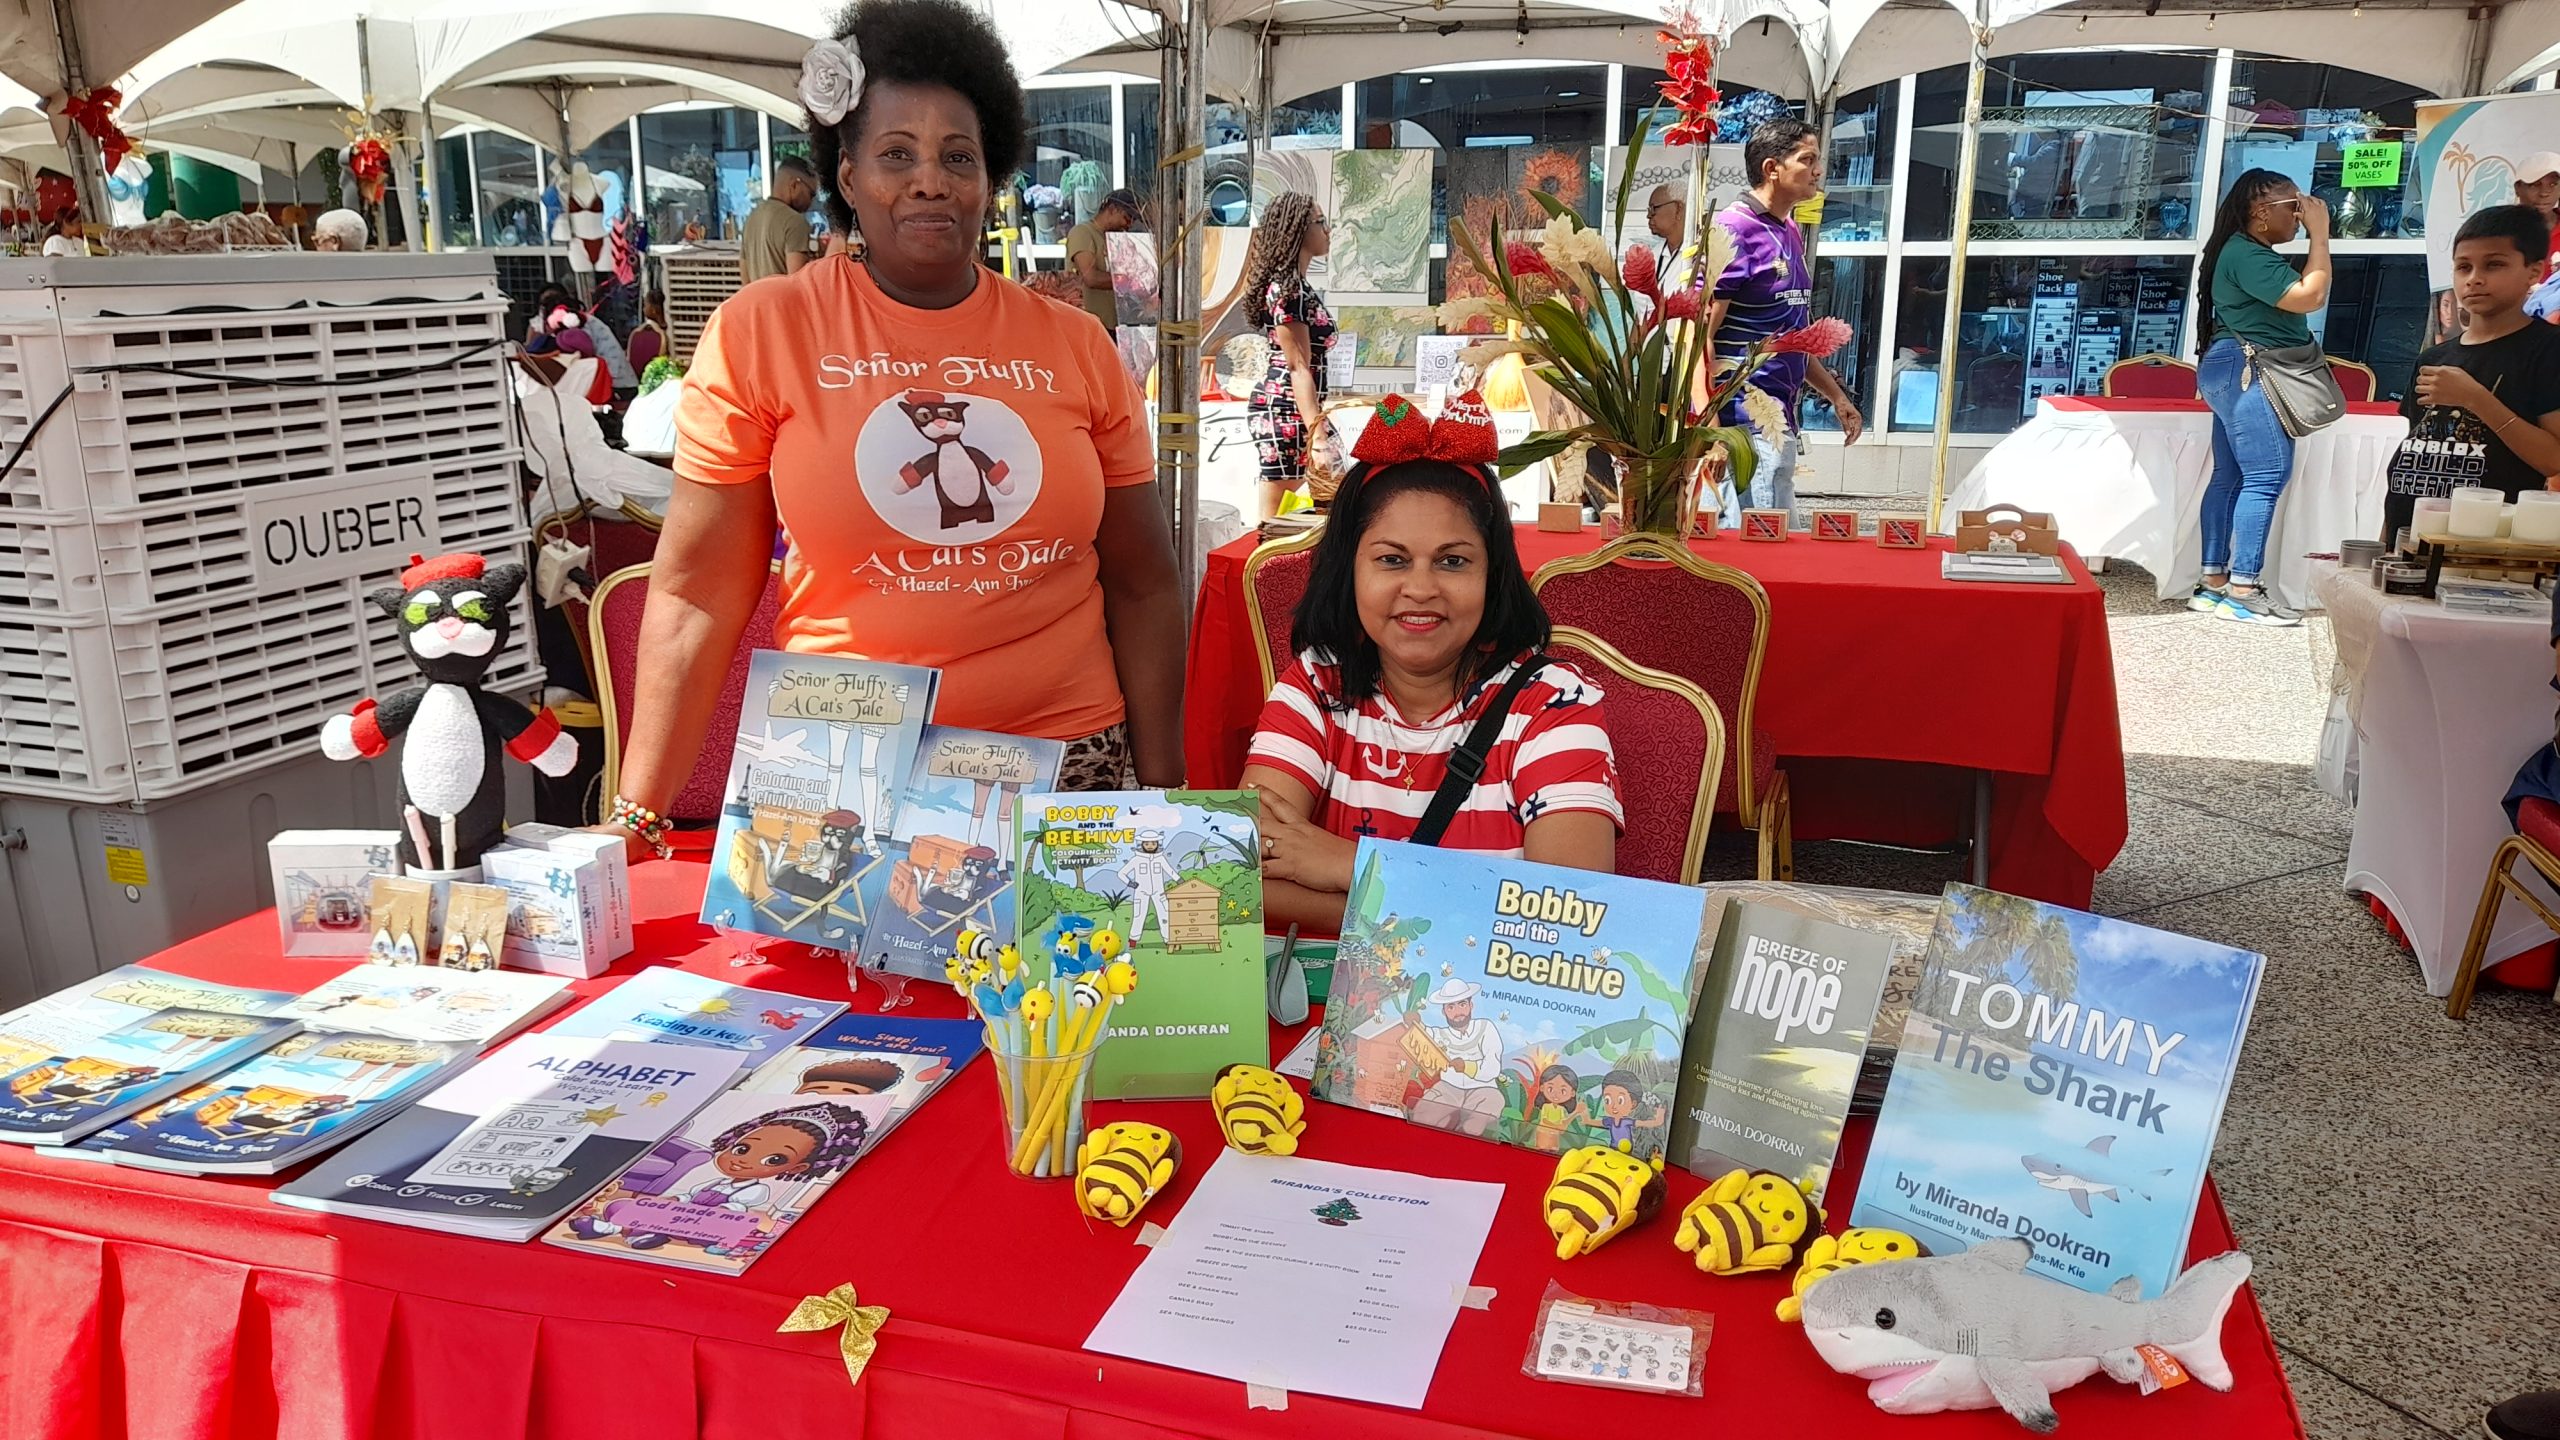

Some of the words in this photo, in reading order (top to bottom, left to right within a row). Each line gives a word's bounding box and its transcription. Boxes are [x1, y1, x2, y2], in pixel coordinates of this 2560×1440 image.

[2355, 148, 2387, 157] SALE!
[2348, 161, 2368, 169] 50%
[2372, 160, 2392, 168] OFF
[2355, 170, 2382, 179] VASES
[2038, 272, 2064, 282] Shoe
[2109, 282, 2133, 291] Shoe
[2037, 283, 2062, 293] Rack
[2141, 289, 2167, 298] Shoe
[2140, 301, 2165, 309] Rack
[817, 352, 928, 388] Señor
[938, 356, 1060, 393] Fluffy
[2401, 438, 2487, 457] ROBLOX
[2398, 452, 2486, 477] BUILD
[265, 497, 426, 565] OUBER
[852, 551, 897, 577] A
[898, 545, 986, 573] Cats
[999, 538, 1074, 573] Tale
[779, 669, 830, 691] Señor
[784, 695, 803, 714] A
[805, 695, 843, 714] Cat's
[851, 700, 884, 719] Tale
[939, 740, 979, 756] Señor
[941, 759, 958, 774] A
[960, 759, 989, 776] Cat's
[992, 763, 1021, 779] Tale
[752, 769, 805, 793] Coloring
[806, 779, 831, 795] and
[748, 787, 796, 809] Activity
[796, 794, 827, 813] Book
[800, 816, 820, 826] Lynch
[1045, 805, 1119, 822] BOBBY
[1045, 828, 1136, 846] BEEHIVE
[1051, 849, 1101, 857] COLOURING
[1495, 878, 1607, 936] Bobby
[1493, 919, 1526, 939] and
[1529, 923, 1559, 945] the
[892, 935, 948, 957] Hazel-Ann
[1757, 938, 1819, 969] BREEZE
[1822, 956, 1848, 975] OF
[1485, 940, 1624, 999] Beehive
[1729, 935, 1842, 1043] hope
[1481, 990, 1490, 1000] by
[1492, 990, 1540, 1008] MIRANDA
[1543, 998, 1596, 1018] DOOKRAN
[632, 1013, 698, 1035] Reading
[698, 1027, 715, 1035] is
[1106, 1025, 1149, 1038] ANDA
[1155, 1024, 1230, 1037] DOOKRAN
[1947, 969, 2187, 1077] TOMMY
[837, 1034, 881, 1047] Where
[885, 1042, 910, 1050] are
[909, 1046, 947, 1054] you?
[875, 1033, 918, 1044] Sleep!
[527, 1056, 696, 1087] ALPHABET
[554, 1073, 586, 1084] Color
[590, 1078, 615, 1087] and
[617, 1081, 655, 1091] Learn
[1932, 1023, 2012, 1082] The
[2024, 1052, 2171, 1135] Shark
[557, 1083, 617, 1096] Workbook
[1693, 1063, 1699, 1071] A
[1700, 1066, 1737, 1083] tumultuous
[1738, 1079, 1762, 1093] journey
[1764, 1087, 1773, 1096] of
[1772, 1089, 1809, 1109] discovering
[1696, 1073, 1737, 1093] experiencing
[1737, 1086, 1750, 1096] loss
[1751, 1092, 1765, 1102] and
[1766, 1096, 1799, 1115] rebuilding
[562, 1092, 602, 1105] A-Z
[1688, 1107, 1741, 1136] MIRANDA
[1744, 1126, 1805, 1158] DOOKRAN
[366, 1181, 396, 1192] Color
[426, 1191, 457, 1201] Trace
[489, 1201, 524, 1211] Learn
[1270, 1178, 1342, 1194] MIRANDA'S
[1345, 1190, 1430, 1206] COLLECTION
[635, 1197, 670, 1210] God
[671, 1204, 717, 1218] made
[719, 1213, 745, 1222] me
[669, 1215, 701, 1225] girl.
[1895, 1171, 1921, 1198] by
[1925, 1182, 2009, 1230] Miranda
[2014, 1215, 2111, 1268] Dookran
[694, 1231, 727, 1241] Henry
[1956, 1221, 1969, 1234] by
[2068, 1263, 2086, 1279] Kie
[1196, 1258, 1220, 1266] BREEZE
[1272, 1256, 1308, 1265] COLOURING
[1314, 1262, 1342, 1270] ACTIVITY
[1168, 1295, 1195, 1303] CANVAS
[1174, 1311, 1200, 1319] THEMED
[1201, 1316, 1234, 1324] EARRINGS
